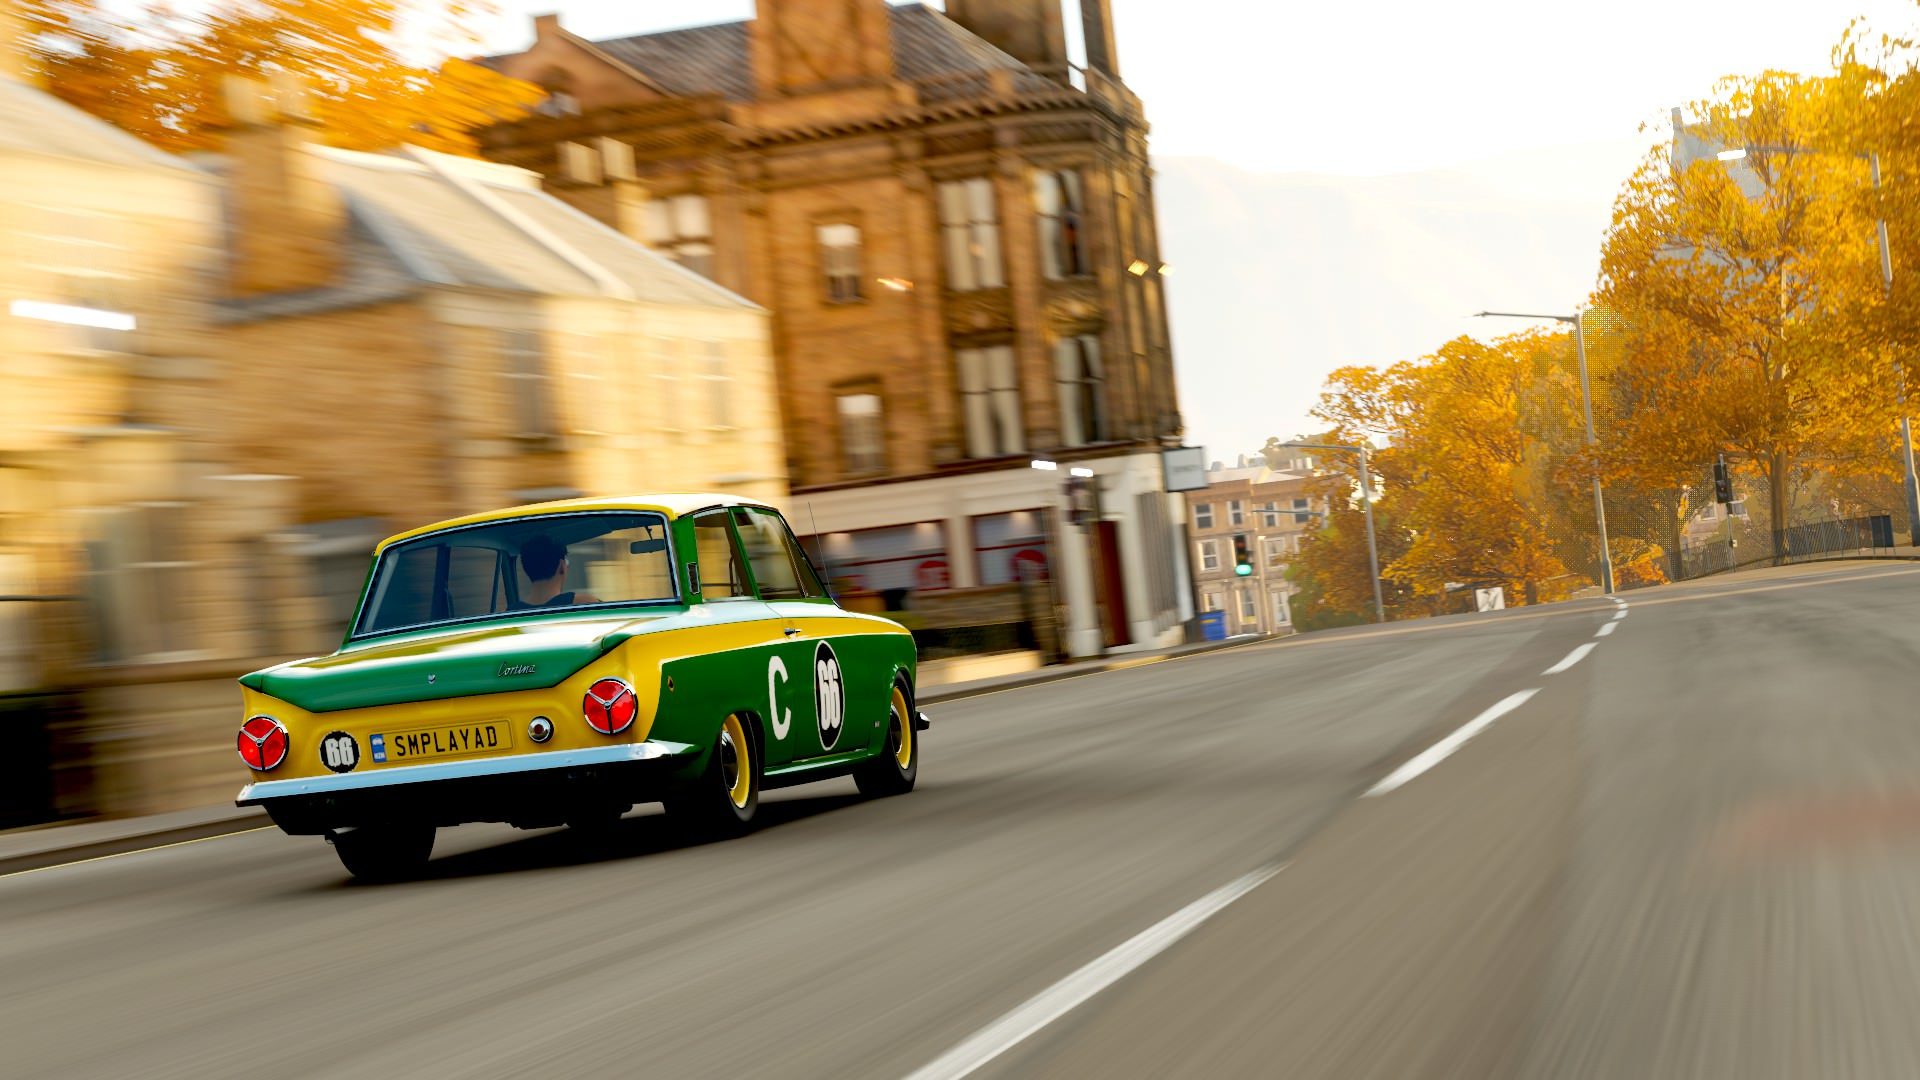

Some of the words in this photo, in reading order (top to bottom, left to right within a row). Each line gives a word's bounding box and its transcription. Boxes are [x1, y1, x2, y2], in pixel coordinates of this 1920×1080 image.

[498, 661, 536, 675] Cortina
[768, 655, 791, 740] C
[817, 658, 841, 730] 66
[325, 737, 355, 767] 66
[395, 726, 497, 756] SMPLAYAD
